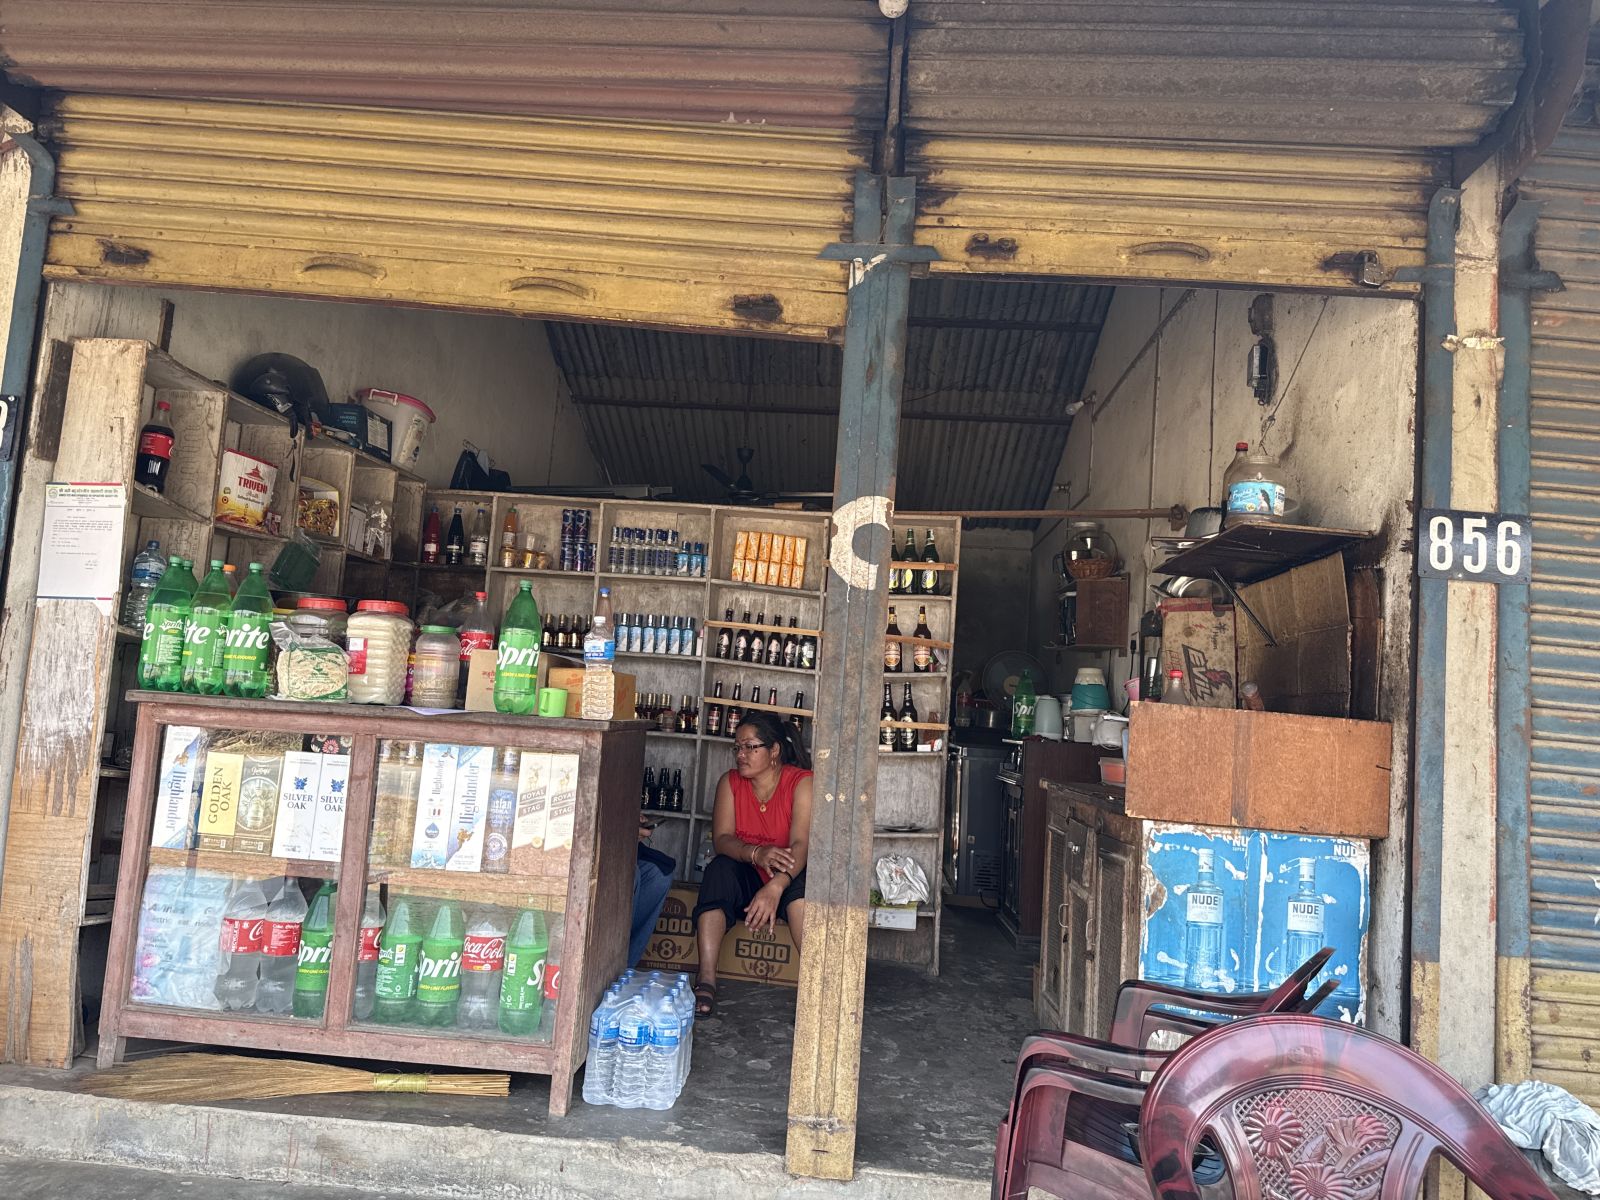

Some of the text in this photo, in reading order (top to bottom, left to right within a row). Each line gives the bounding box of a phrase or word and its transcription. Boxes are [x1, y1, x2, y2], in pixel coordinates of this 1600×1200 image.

[238, 476, 268, 494] TRIVENI
[1429, 516, 1521, 575] 856
[226, 624, 270, 649] rite
[432, 759, 444, 795] Highlander
[166, 770, 187, 831] Highlander
[208, 766, 224, 824] GOLDEN
[220, 780, 232, 811] OAK
[283, 793, 313, 803] SILVER
[459, 763, 479, 824] Highlander
[521, 789, 545, 801] ROYAL
[287, 801, 307, 810] OAK
[324, 803, 343, 812] OAK
[522, 804, 541, 815] STAG
[554, 807, 572, 817] STAG
[1191, 894, 1218, 906] NUDE
[1292, 904, 1319, 916] NUDE
[656, 918, 693, 934] 000
[752, 931, 776, 942] GOLD
[662, 939, 673, 958] 8
[738, 941, 789, 961] 5000
[756, 960, 767, 975] 8
